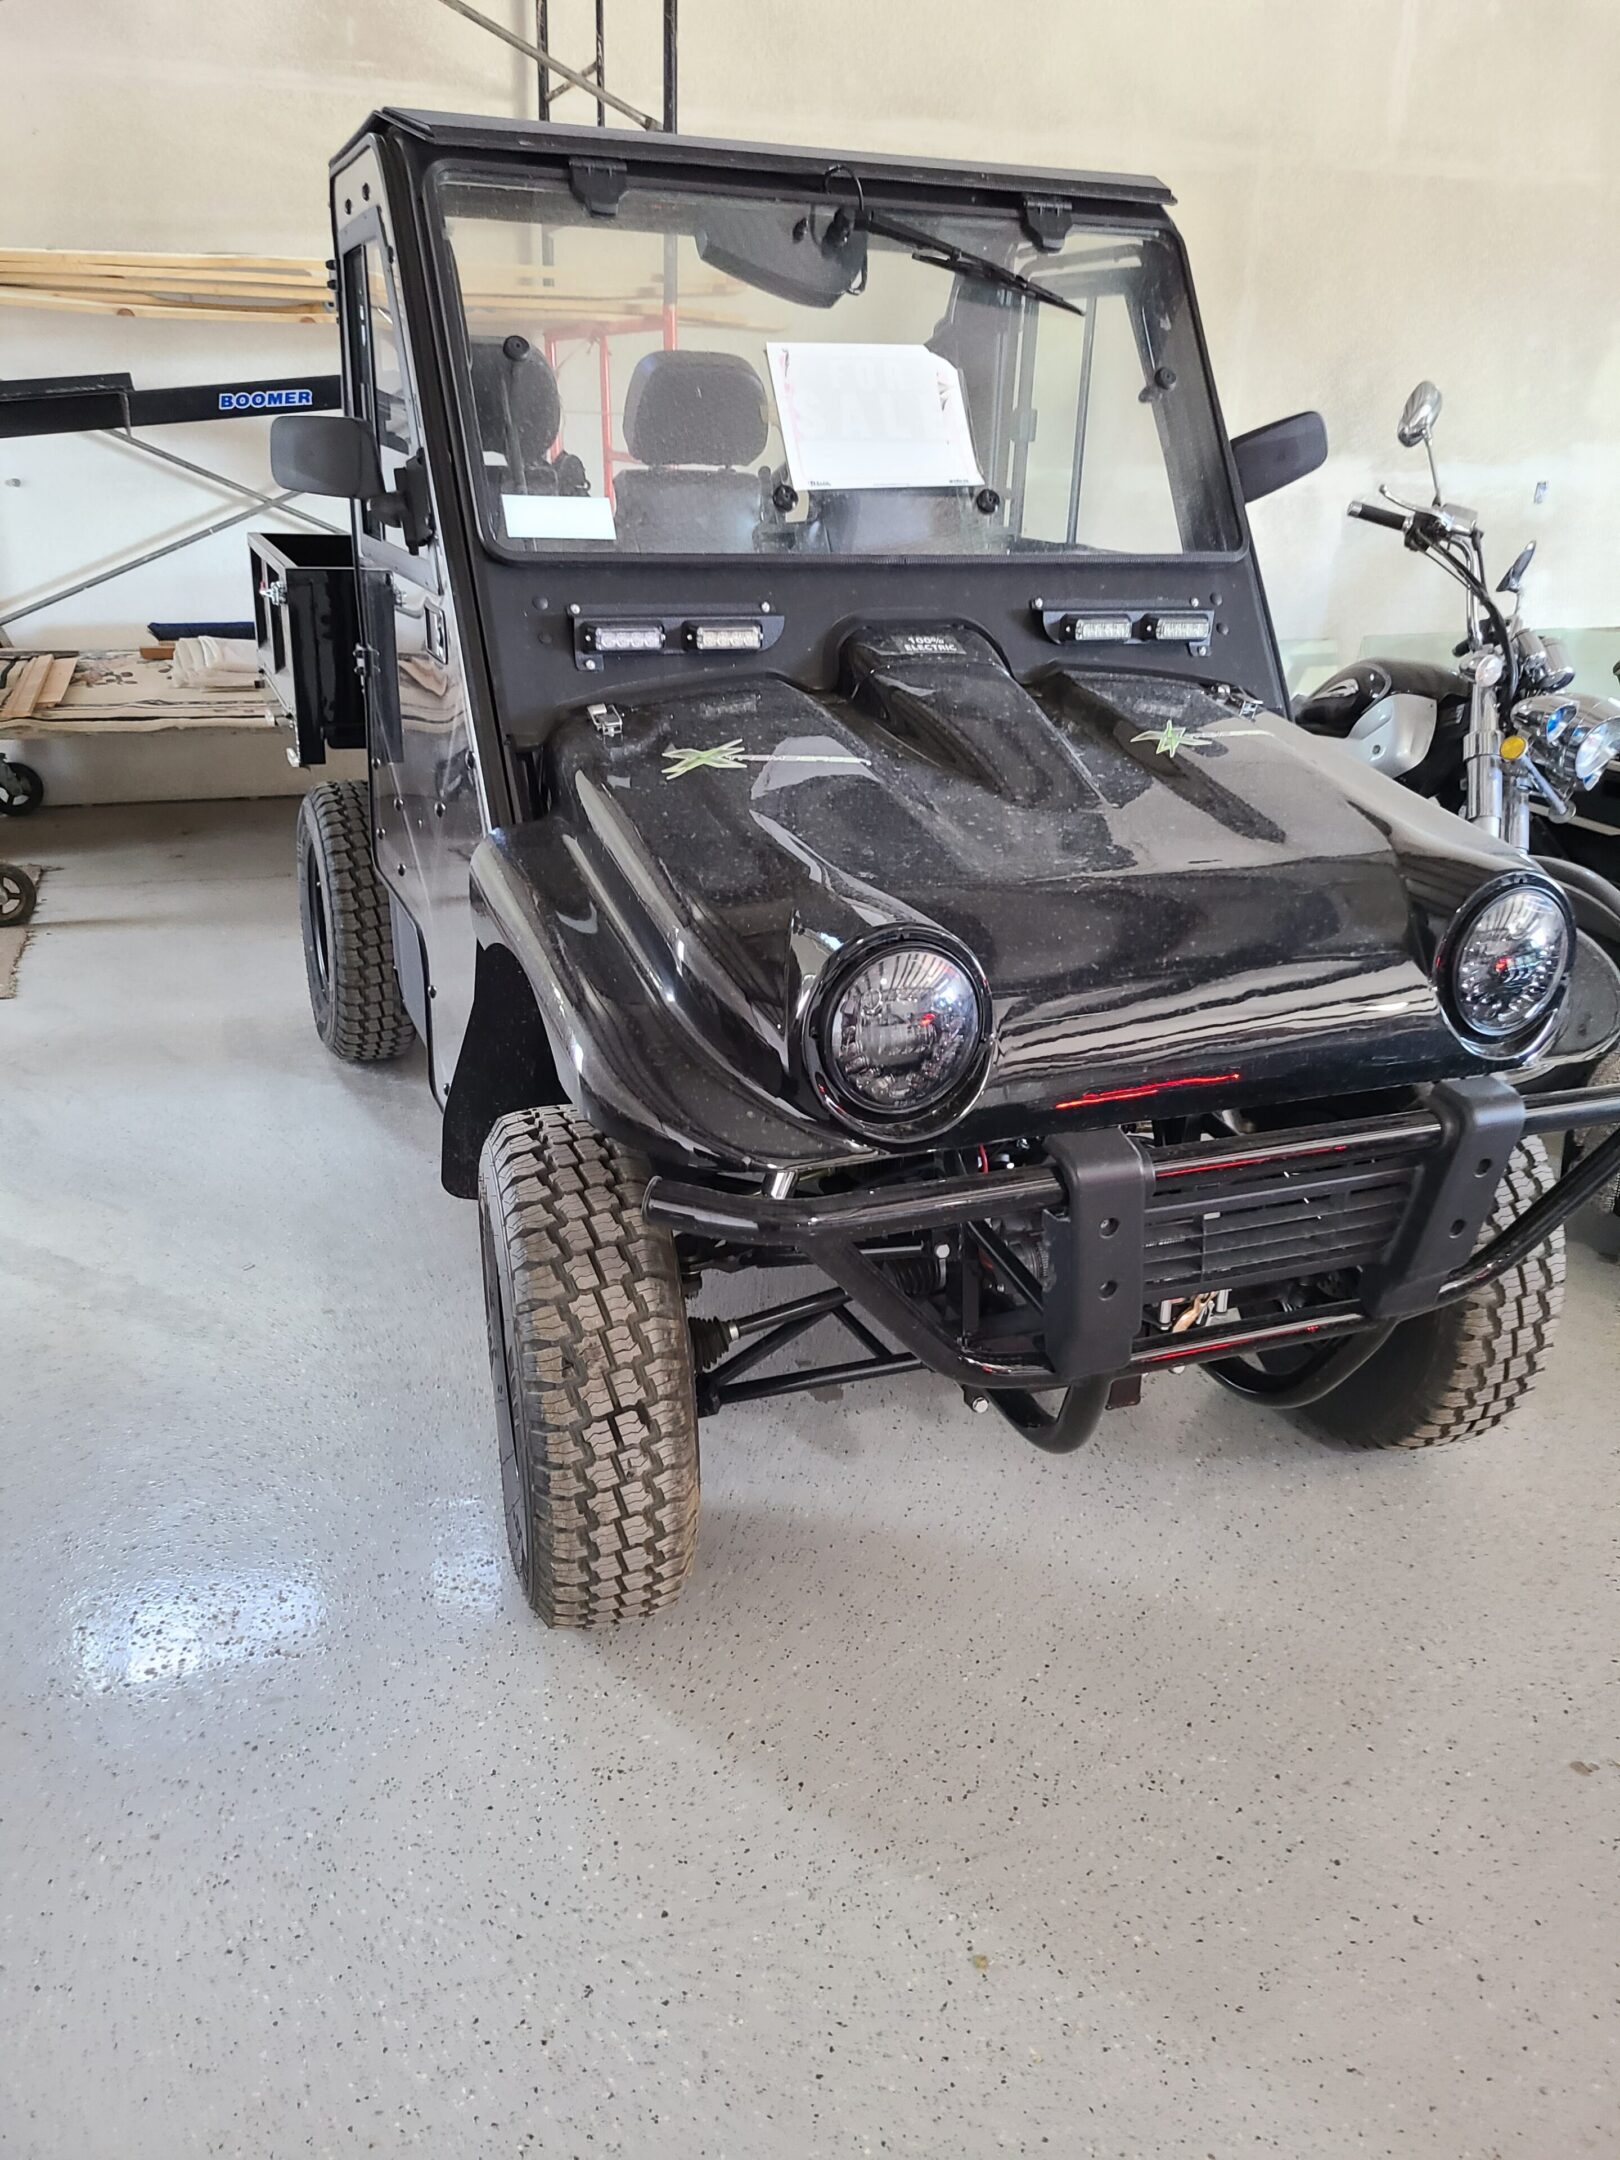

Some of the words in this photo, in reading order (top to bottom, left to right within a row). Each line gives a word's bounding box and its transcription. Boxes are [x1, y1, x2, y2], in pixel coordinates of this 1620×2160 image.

[219, 390, 312, 410] BOOMER
[908, 635, 945, 645] 100%
[904, 643, 957, 652] ELECTRIC
